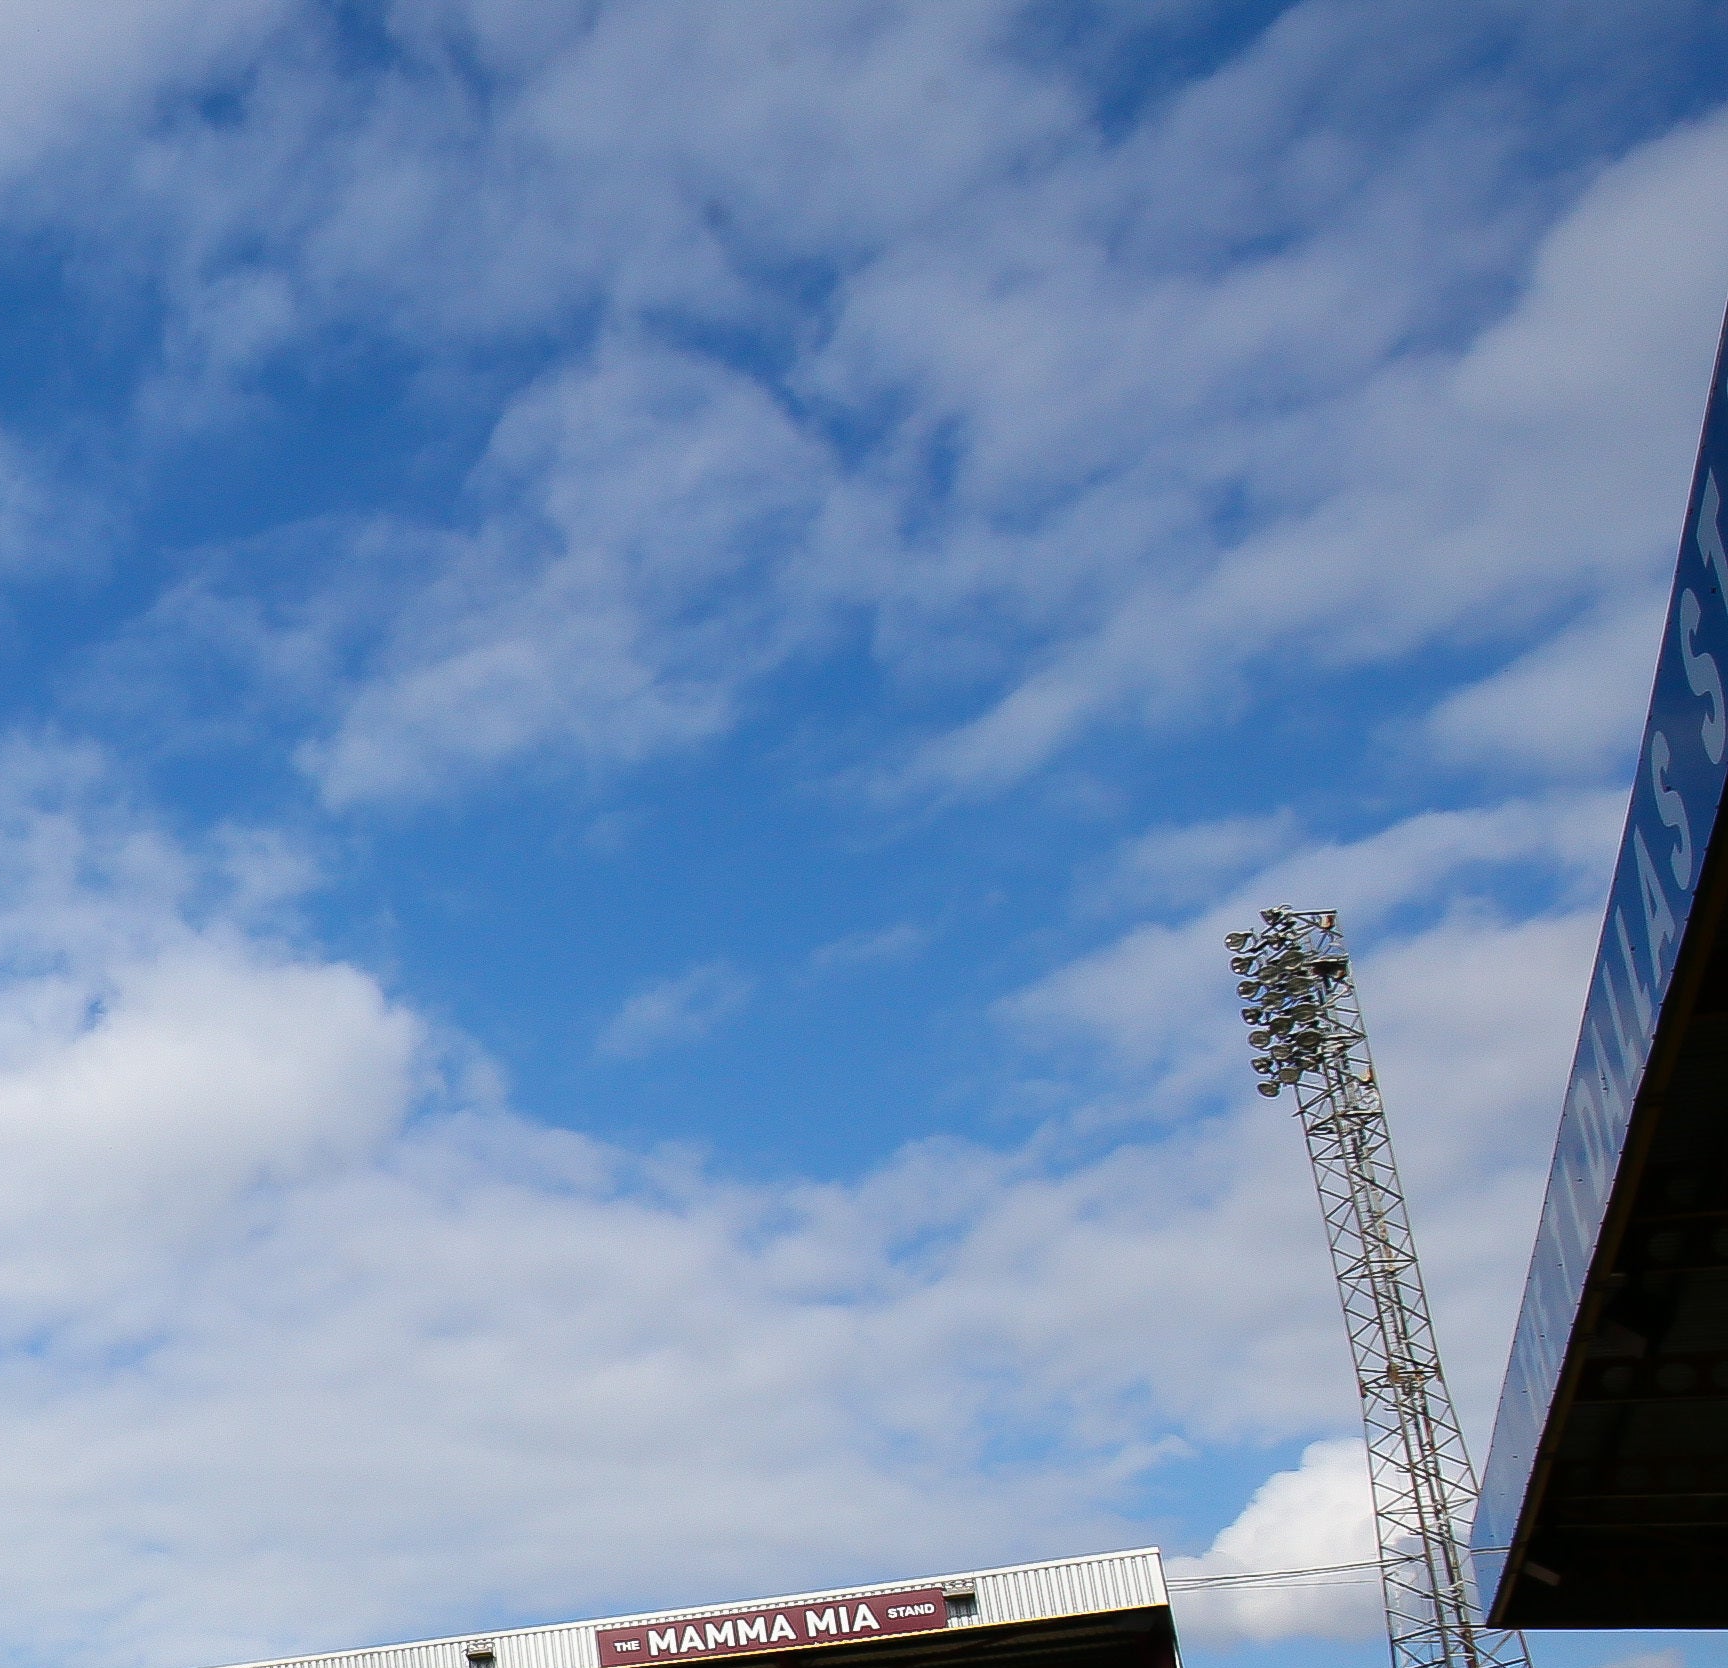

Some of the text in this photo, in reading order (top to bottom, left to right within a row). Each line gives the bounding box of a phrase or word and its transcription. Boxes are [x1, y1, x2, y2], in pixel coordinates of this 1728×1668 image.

[1575, 728, 1693, 1207] DALLAS
[613, 1602, 935, 1656] THE MAMMA MIA STAND
